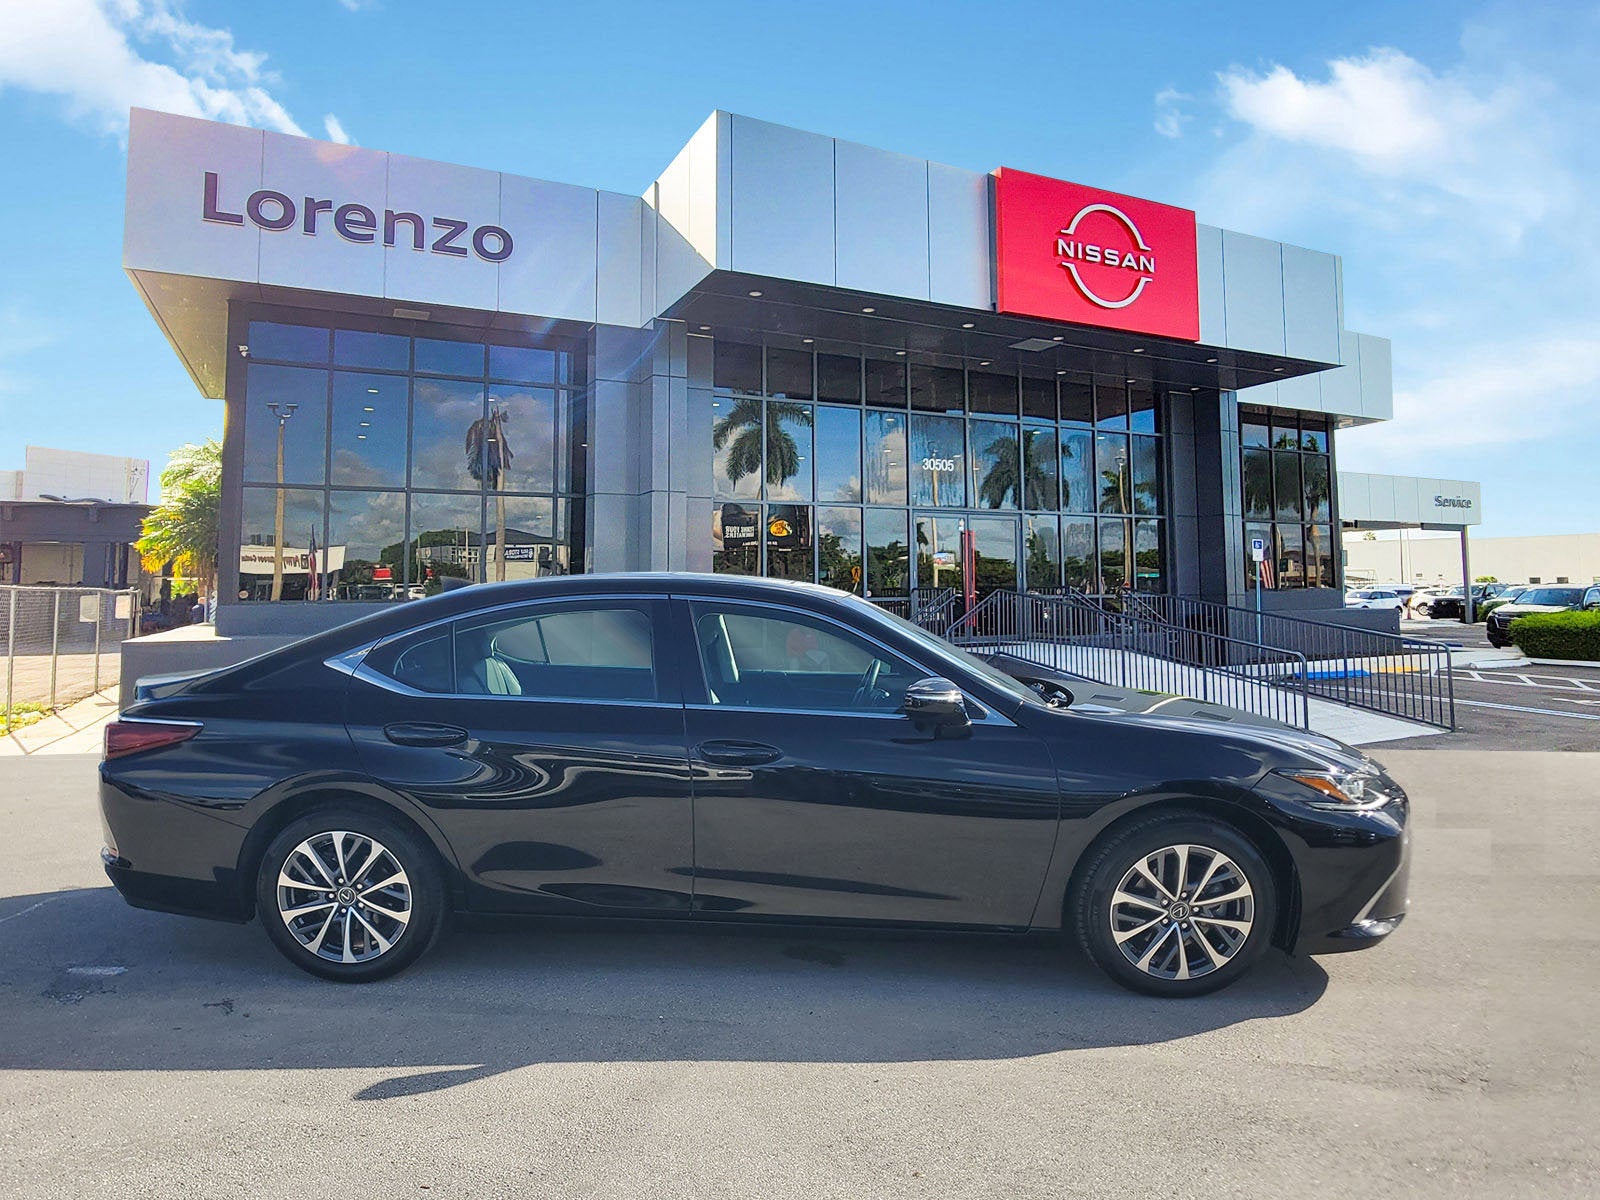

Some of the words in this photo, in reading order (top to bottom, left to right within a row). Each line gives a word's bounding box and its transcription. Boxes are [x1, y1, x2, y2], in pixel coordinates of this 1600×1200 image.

[201, 170, 514, 262] Lorenzo
[1057, 238, 1155, 273] NISSAN
[922, 457, 955, 472] 30505
[1434, 494, 1472, 508] Service
